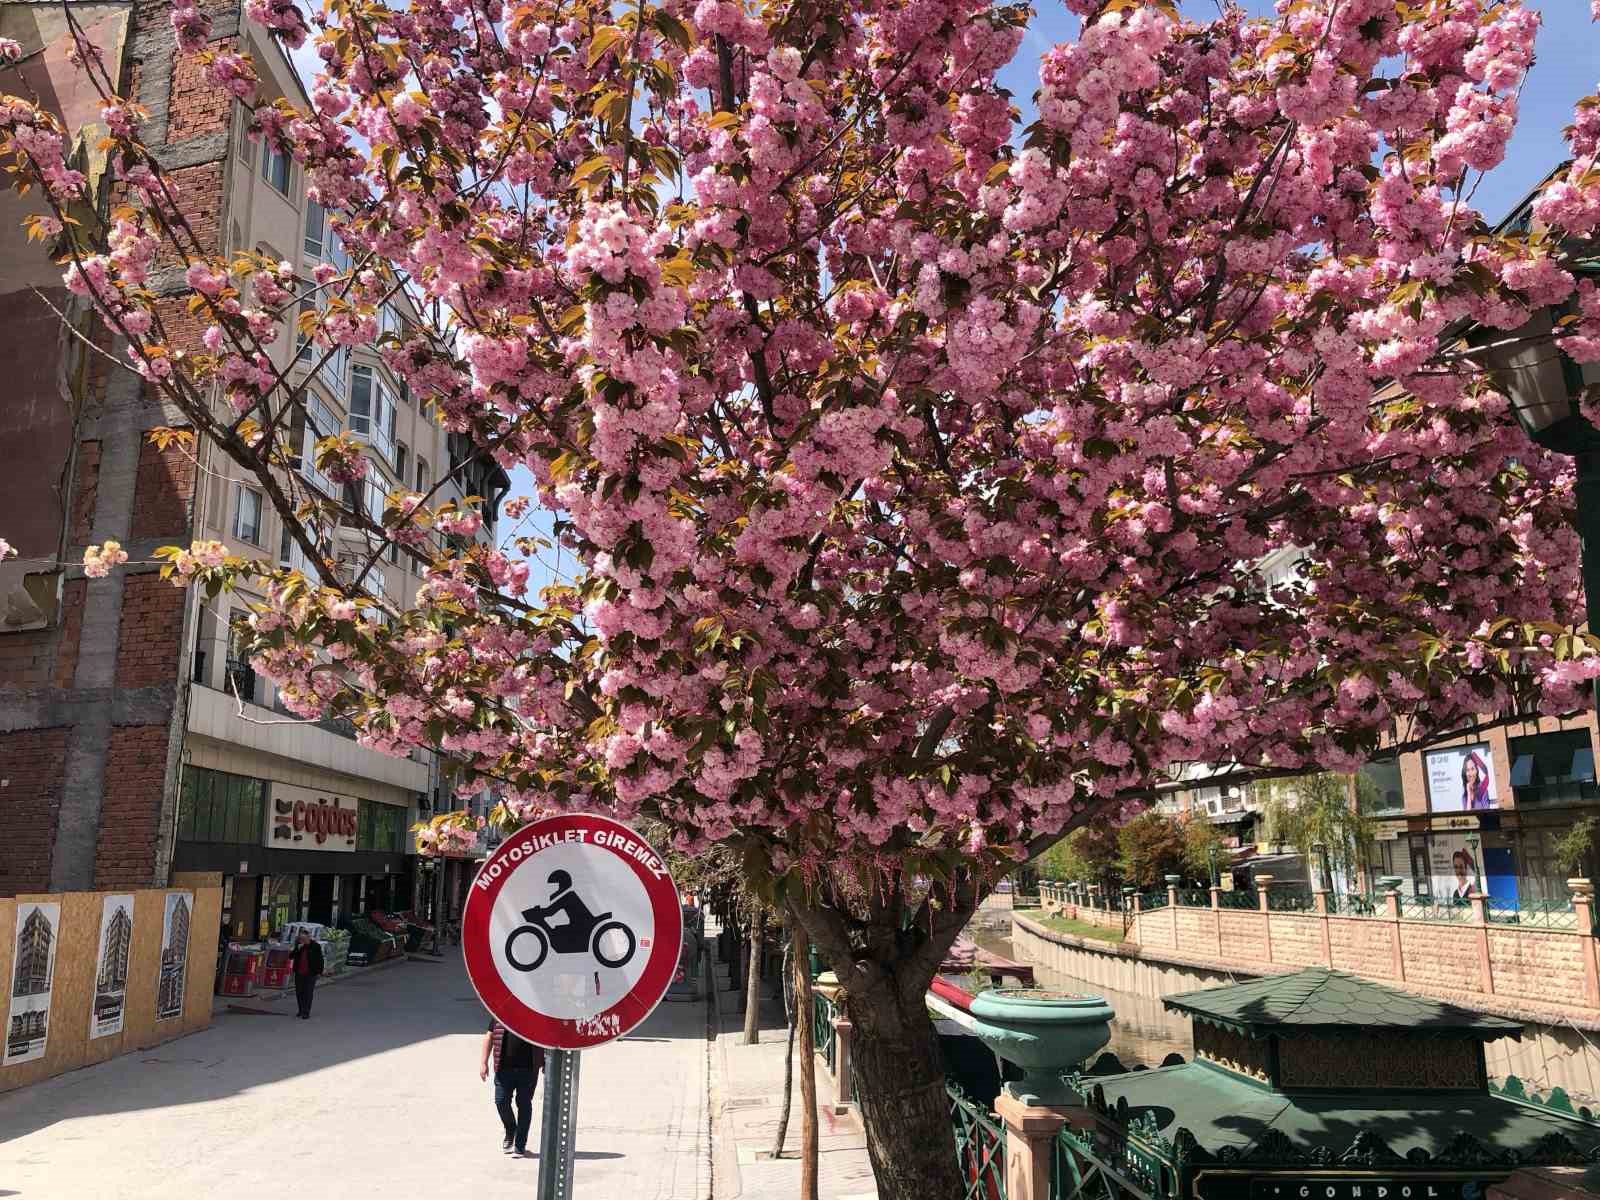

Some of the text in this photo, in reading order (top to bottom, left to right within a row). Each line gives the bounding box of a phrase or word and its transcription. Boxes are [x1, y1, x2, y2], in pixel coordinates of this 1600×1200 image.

[476, 829, 668, 890] MOTOSİKLET GİREMEZ
[1299, 1185, 1438, 1198] GONDOL
